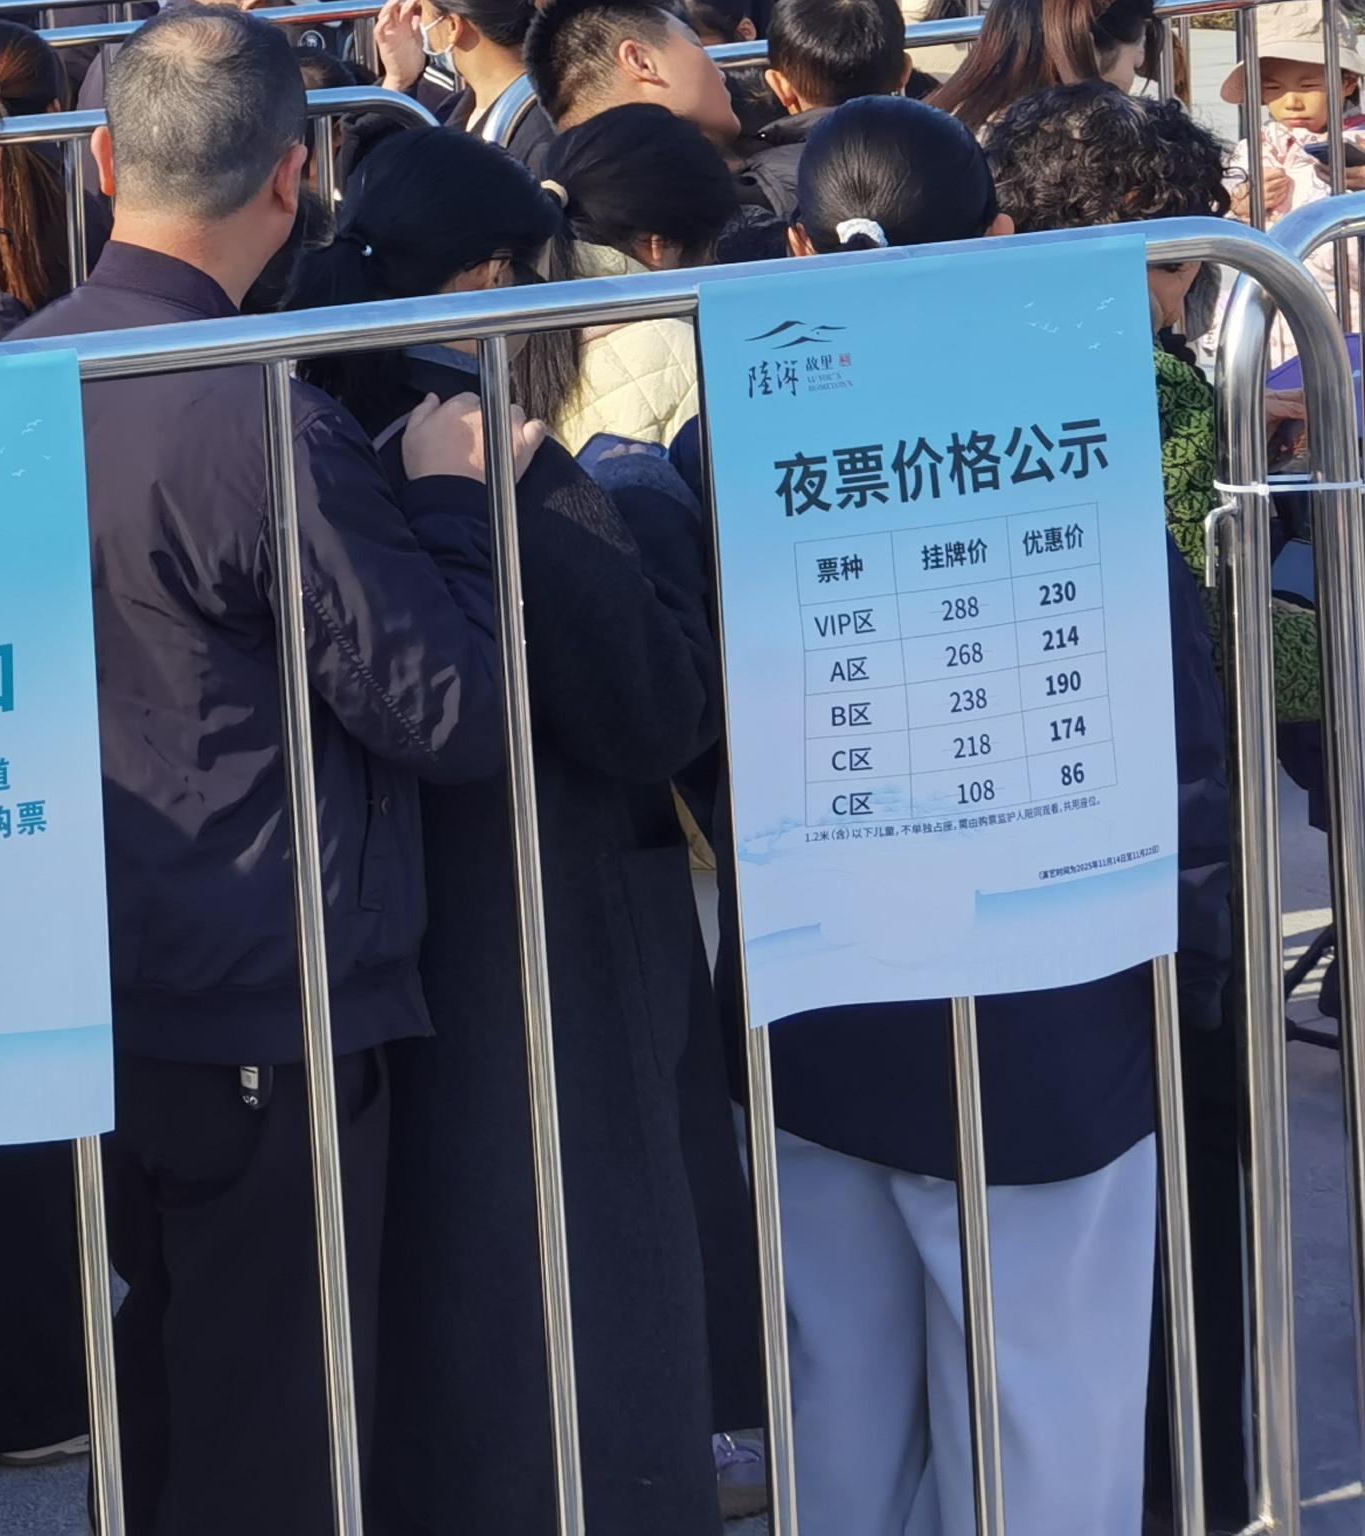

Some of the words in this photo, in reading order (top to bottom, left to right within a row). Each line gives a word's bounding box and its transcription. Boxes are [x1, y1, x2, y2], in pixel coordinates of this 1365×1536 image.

[774, 419, 1108, 516] 夜票价格公示
[816, 554, 863, 583] 票种
[922, 538, 987, 570] 挂牌价
[1023, 524, 1083, 556] 优惠价
[814, 609, 876, 637] VIP区
[942, 597, 979, 621] 288
[1040, 581, 1075, 606] 230
[830, 657, 869, 682] A区
[946, 642, 983, 667] 268
[1043, 626, 1079, 651] 214
[832, 702, 871, 726] B区
[950, 688, 987, 713] 238
[1046, 671, 1081, 696] 190
[832, 748, 872, 771] C区
[954, 734, 991, 758] 218
[1050, 716, 1085, 741] 174
[832, 792, 873, 815] C区
[958, 780, 994, 804] 108
[1061, 763, 1084, 786] 86
